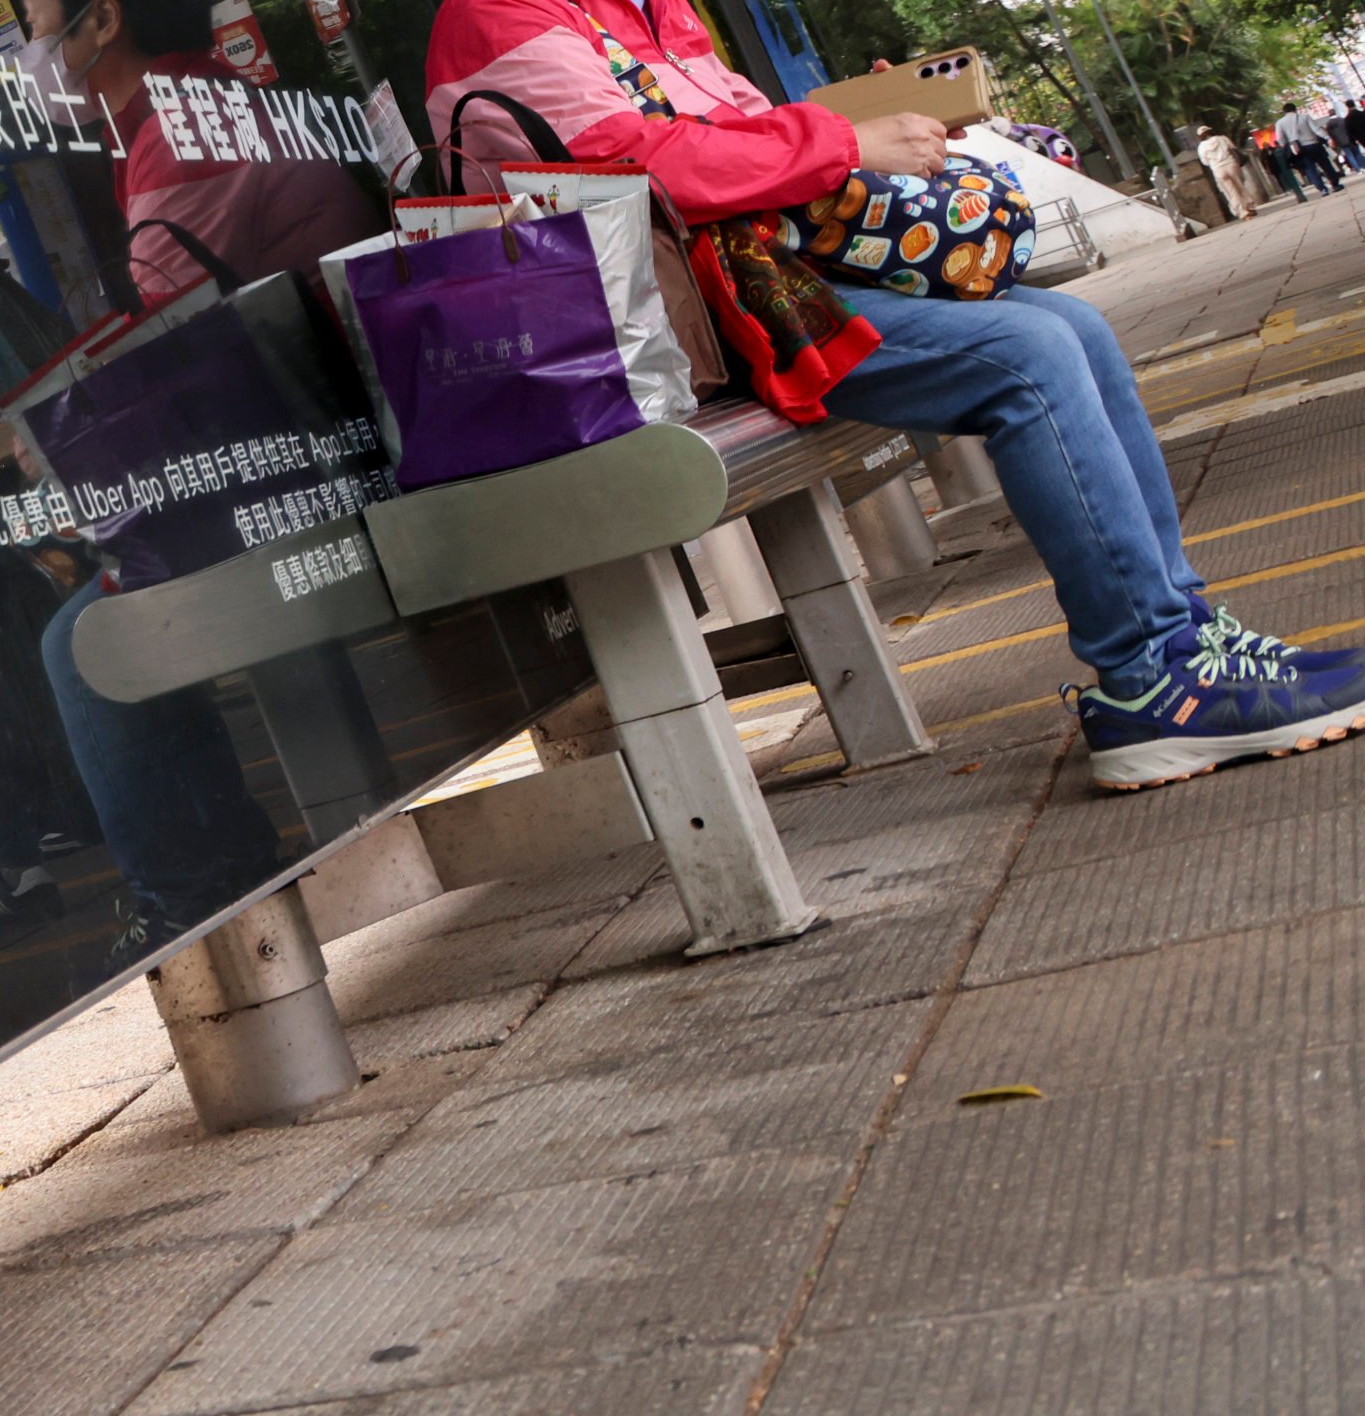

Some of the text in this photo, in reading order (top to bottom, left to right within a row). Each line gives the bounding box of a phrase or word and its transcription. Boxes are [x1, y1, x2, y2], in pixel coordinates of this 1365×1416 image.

[143, 70, 271, 164] 程程減
[260, 88, 380, 168] HK$10
[73, 485, 133, 522] Uber
[127, 473, 165, 516] App
